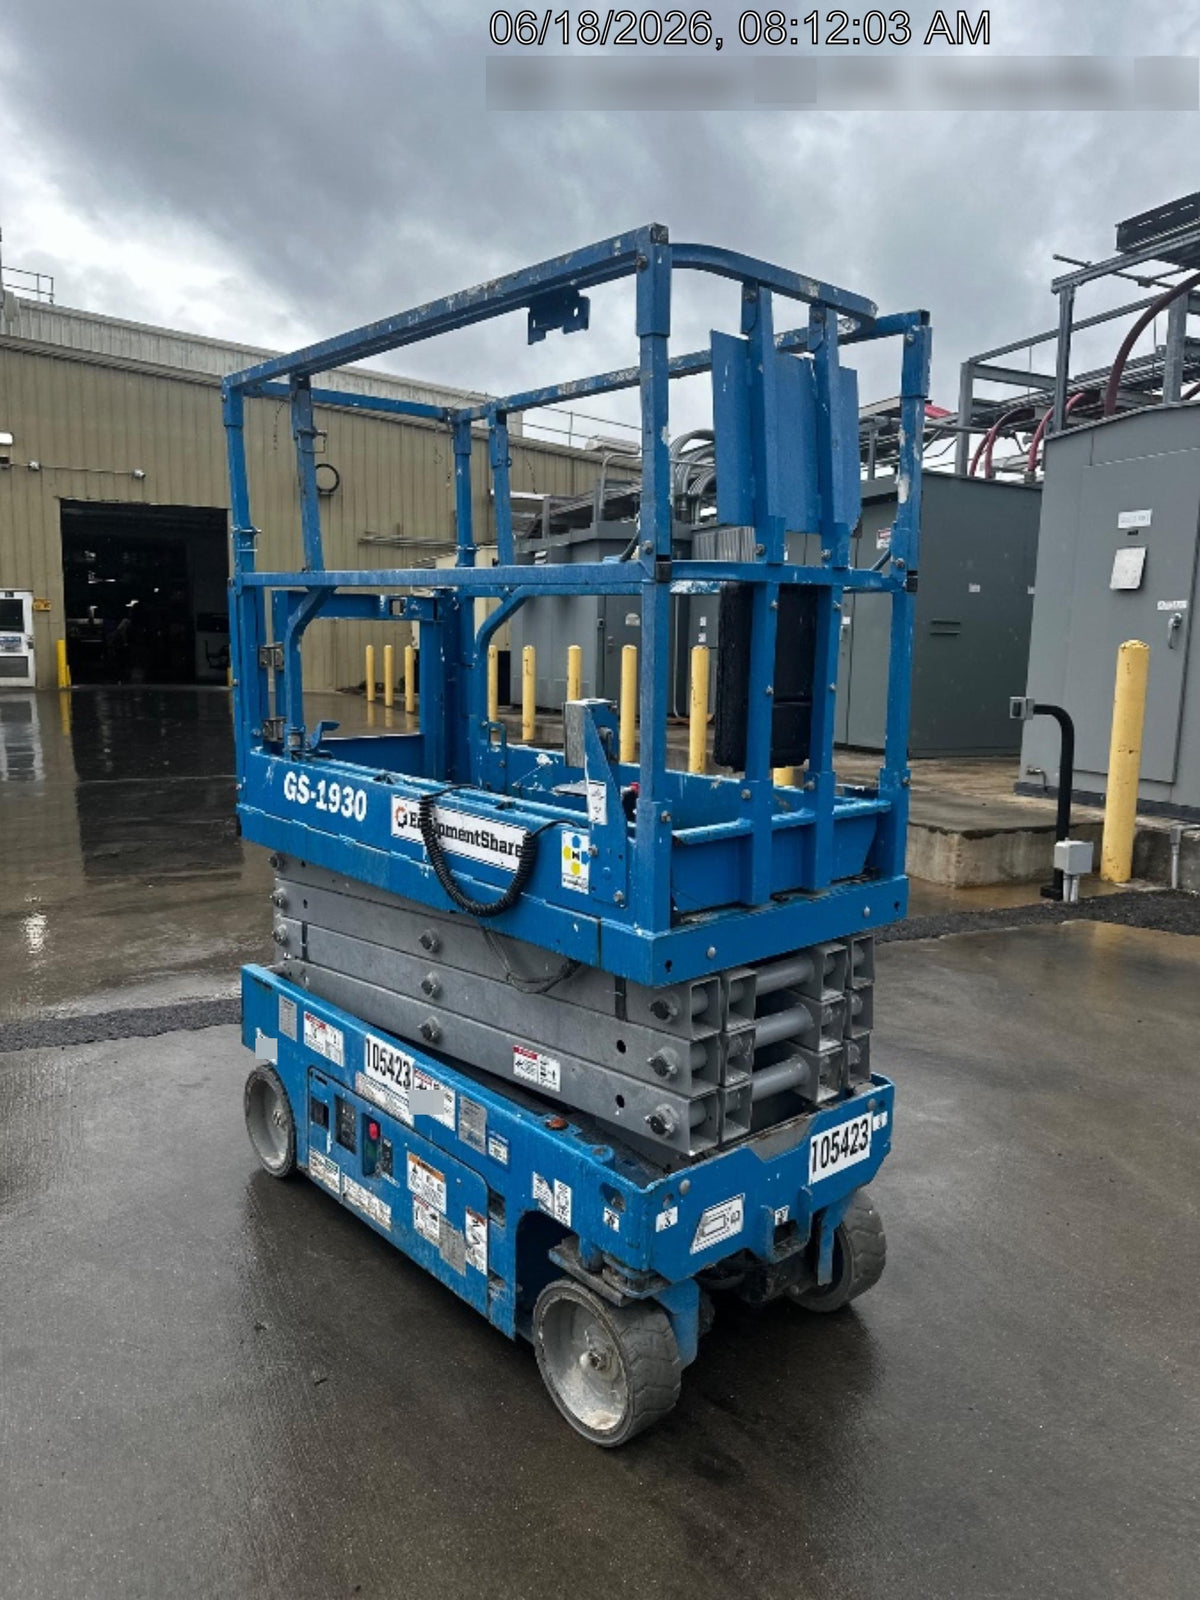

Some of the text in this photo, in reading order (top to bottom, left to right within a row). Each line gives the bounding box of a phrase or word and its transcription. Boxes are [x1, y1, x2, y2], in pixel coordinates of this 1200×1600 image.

[284, 771, 367, 822] GS-1930
[409, 811, 523, 858] EpmentShare
[366, 1038, 411, 1088] 105423
[812, 1118, 868, 1174] 105423
